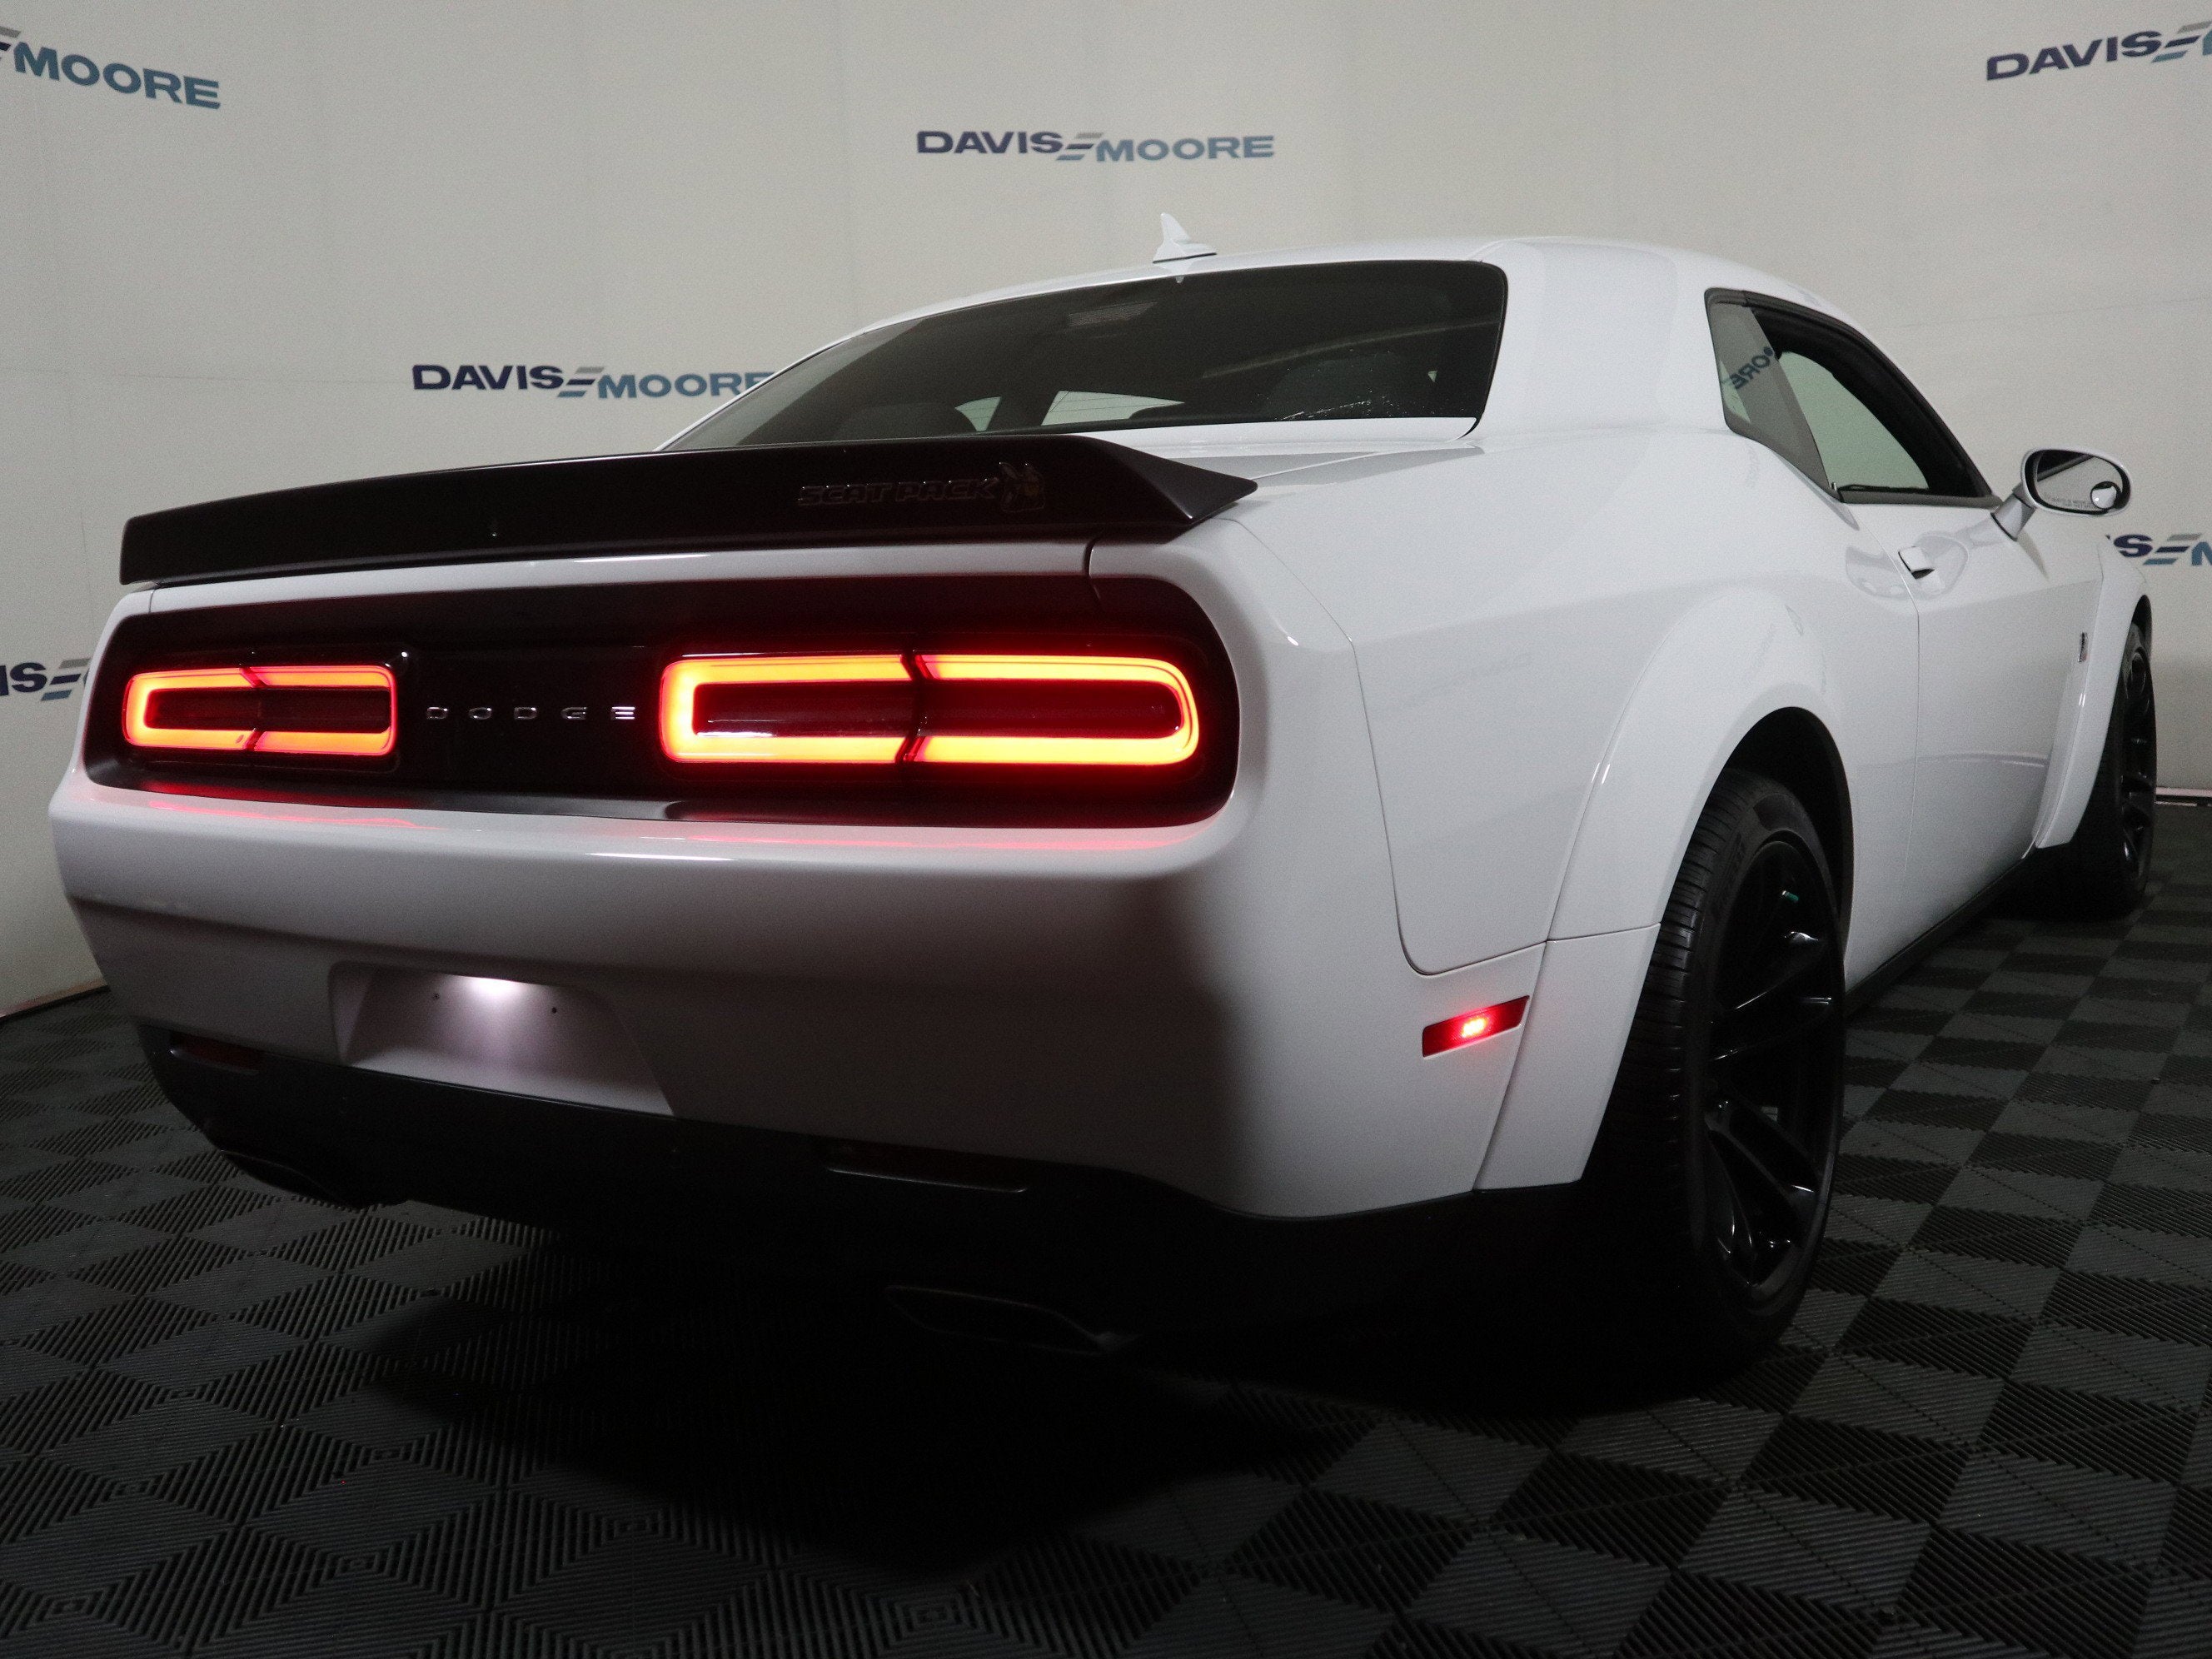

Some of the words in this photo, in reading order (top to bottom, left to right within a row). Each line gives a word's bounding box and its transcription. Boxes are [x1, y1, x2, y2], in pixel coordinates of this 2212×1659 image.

[1986, 30, 2162, 81] DAVIS
[13, 41, 221, 110] MOORE
[916, 131, 1063, 154] DAVIS
[1096, 135, 1274, 162] MOORE
[412, 365, 564, 391] DAVIS
[426, 705, 635, 720] DODGE
